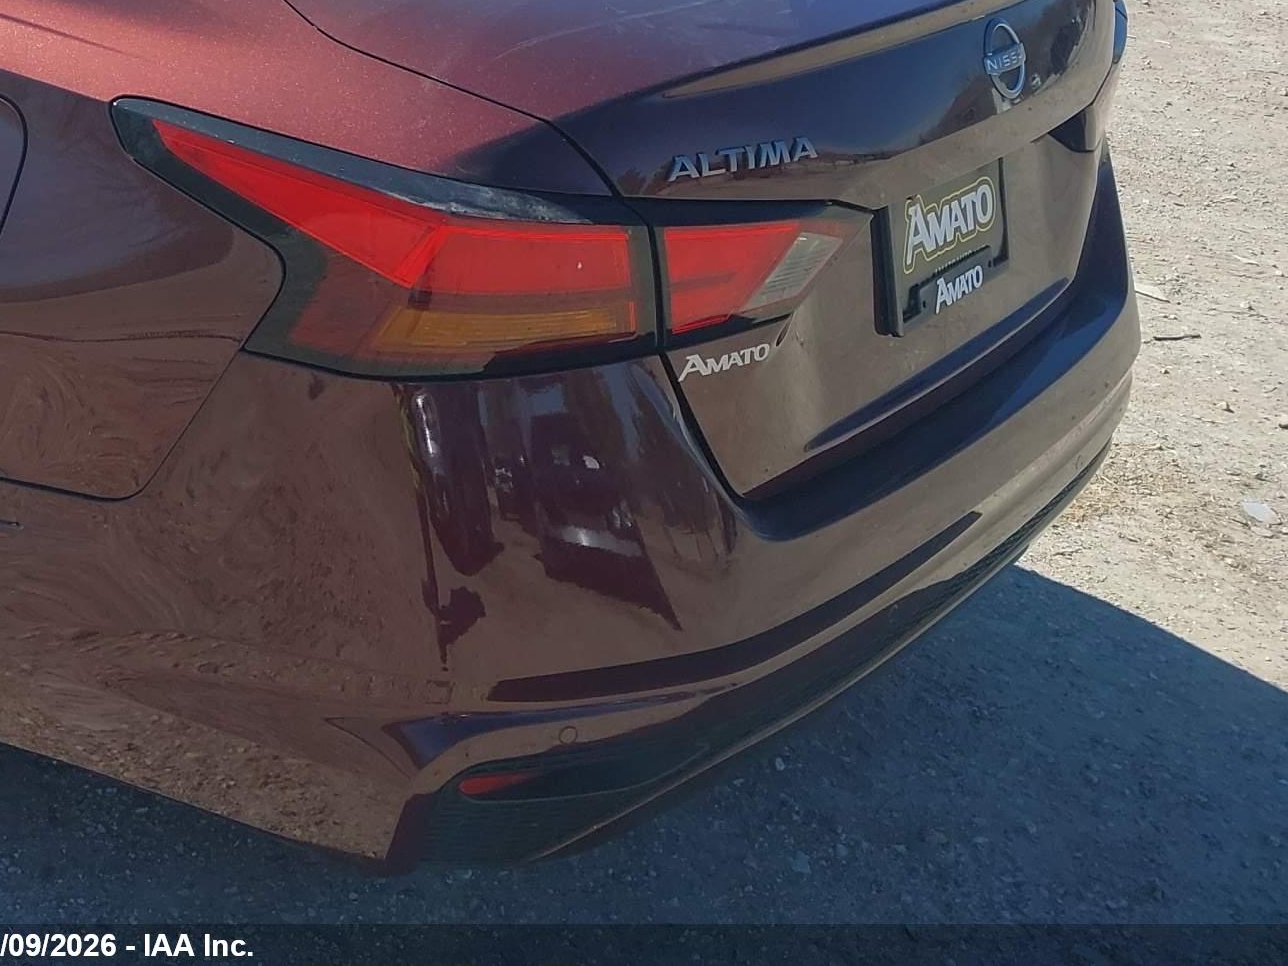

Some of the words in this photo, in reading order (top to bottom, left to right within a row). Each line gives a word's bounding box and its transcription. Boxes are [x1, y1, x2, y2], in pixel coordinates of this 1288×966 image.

[667, 136, 819, 183] ALTIMA
[906, 184, 993, 266] AMATO
[935, 265, 984, 315] AMATO
[677, 343, 770, 383] AMATO
